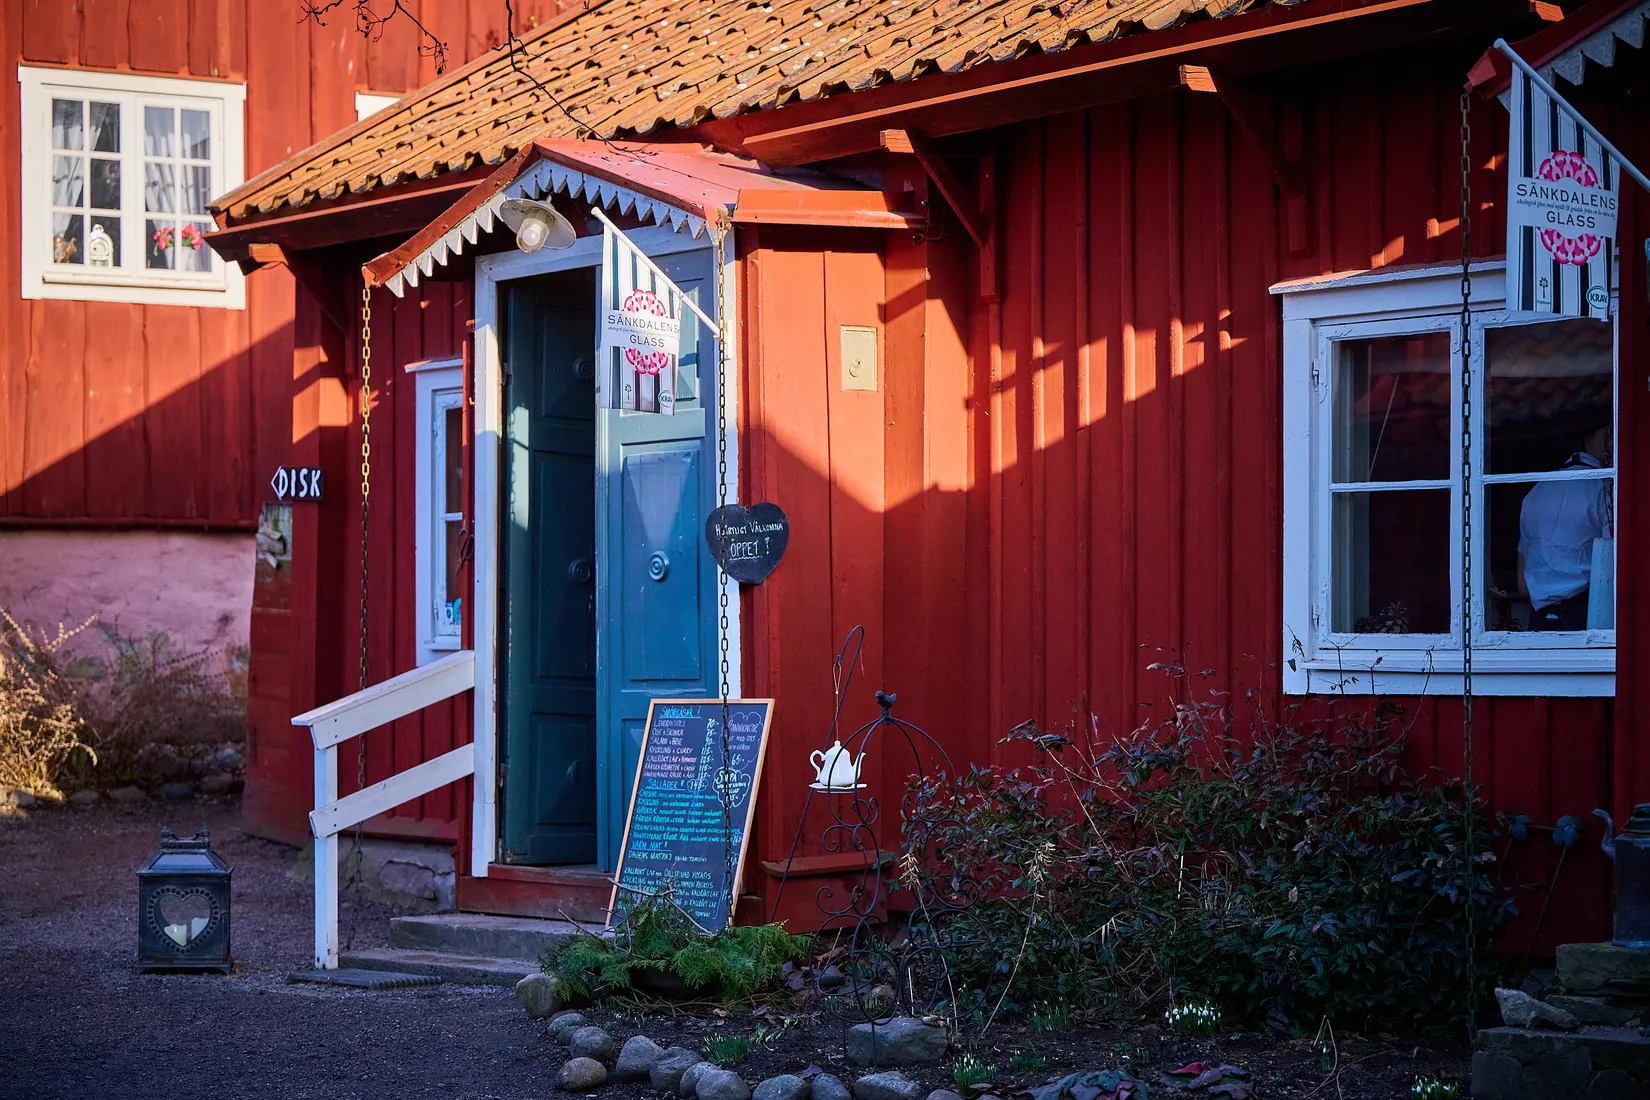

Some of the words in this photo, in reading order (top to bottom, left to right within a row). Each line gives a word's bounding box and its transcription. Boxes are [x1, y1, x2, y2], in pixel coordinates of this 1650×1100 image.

[1516, 182, 1616, 210] SÄNKDALENS
[1546, 210, 1596, 229] GLASS
[607, 313, 680, 334] SÄNKDALENS
[629, 334, 665, 348] GLASS
[279, 468, 321, 498] DISK
[730, 538, 759, 557] ÖPPET
